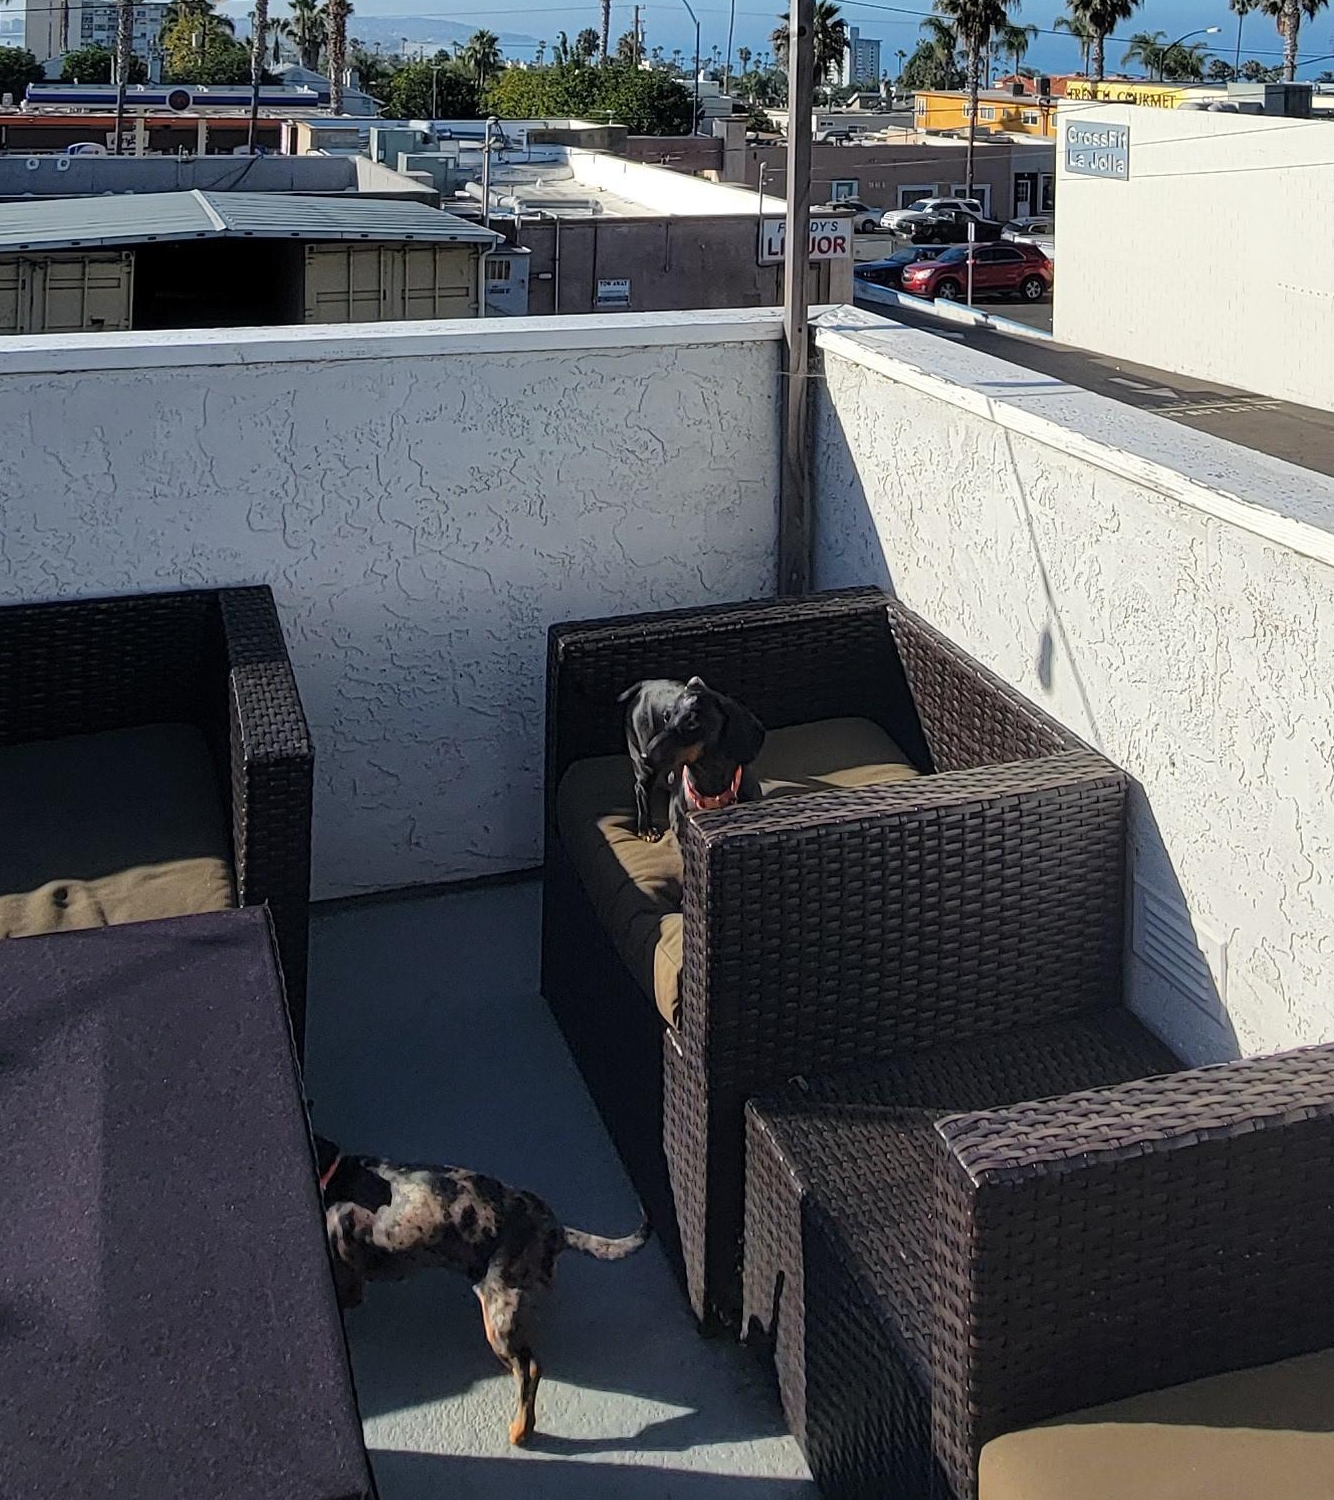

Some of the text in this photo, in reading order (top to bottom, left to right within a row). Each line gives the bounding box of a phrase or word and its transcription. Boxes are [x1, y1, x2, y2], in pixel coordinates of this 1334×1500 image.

[1069, 87, 1111, 101] FRENCH
[1067, 125, 1128, 150] CrossFit
[1067, 148, 1125, 174] La Jolla
[777, 221, 839, 233] FDY'S
[768, 235, 847, 256] LIUOR
